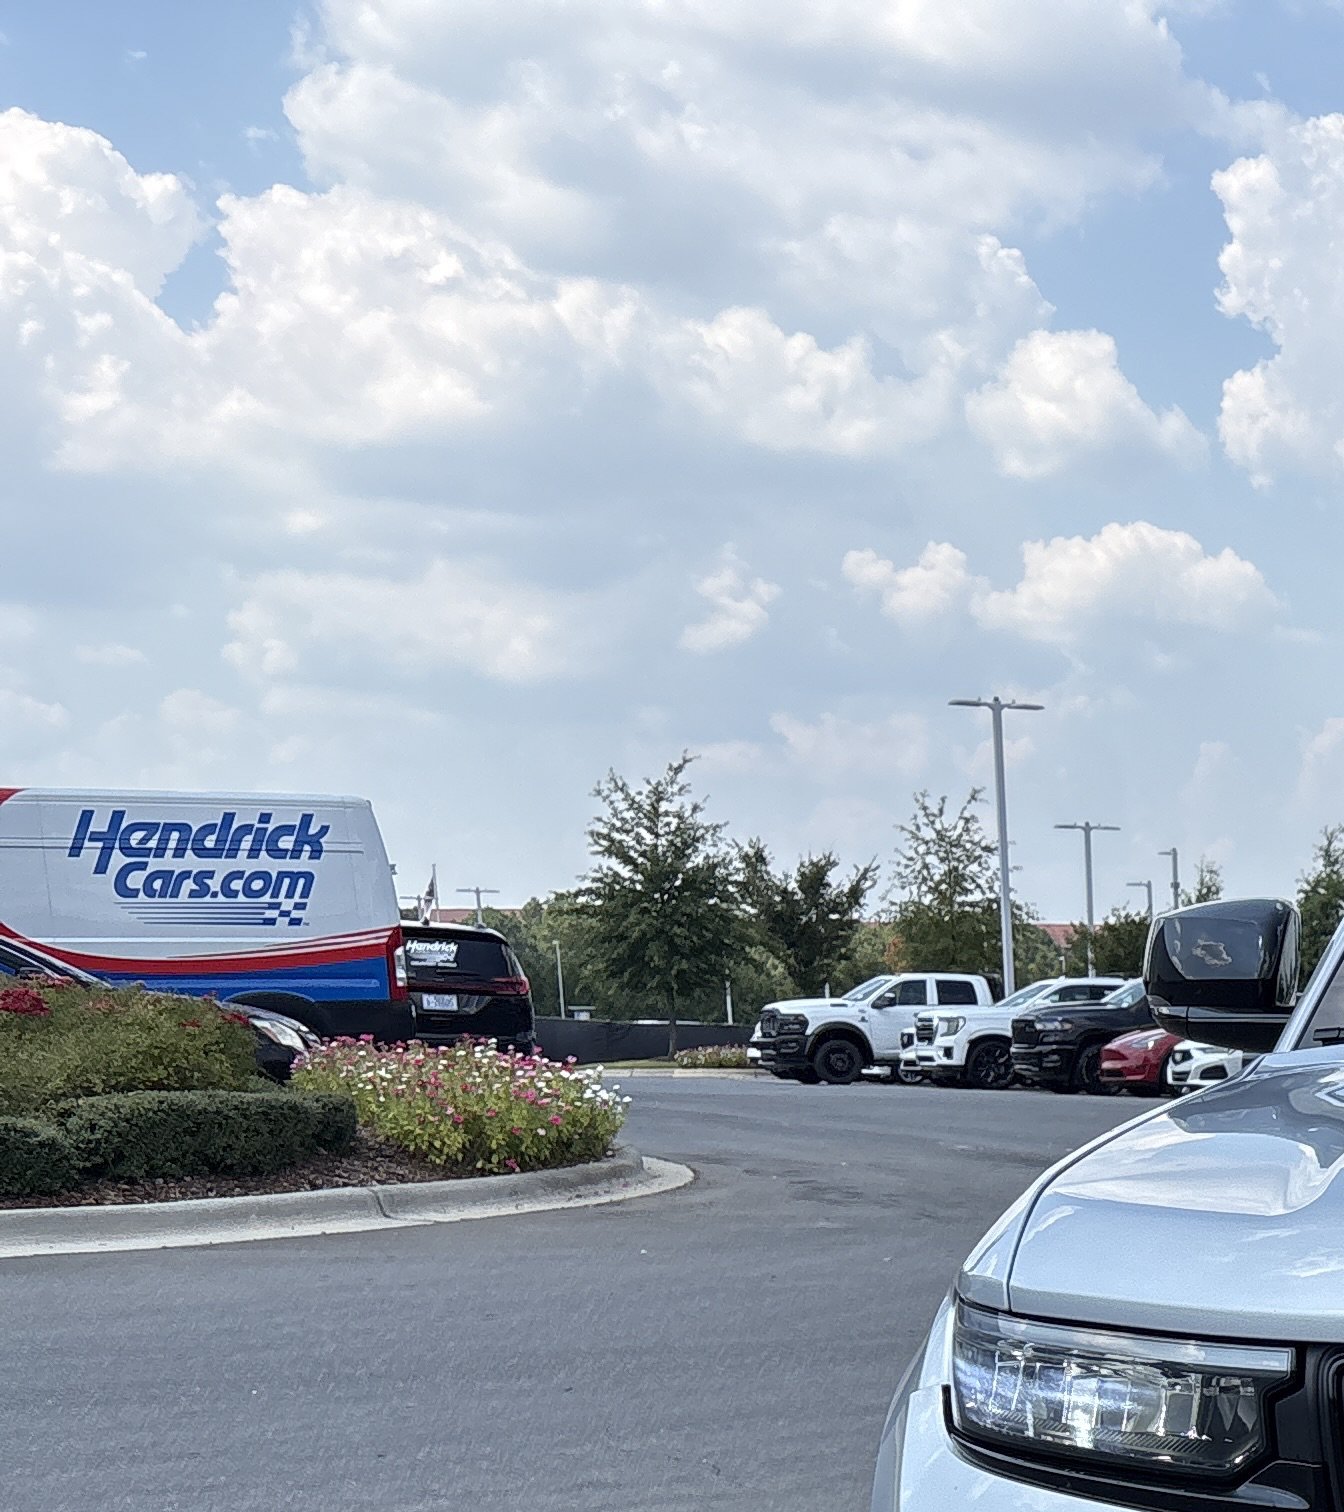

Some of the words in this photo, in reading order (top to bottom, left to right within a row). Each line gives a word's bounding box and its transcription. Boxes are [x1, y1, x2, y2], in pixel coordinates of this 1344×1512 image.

[68, 810, 330, 874] Hendrick
[114, 861, 315, 899] Cars.com
[405, 940, 458, 953] Hendrick
